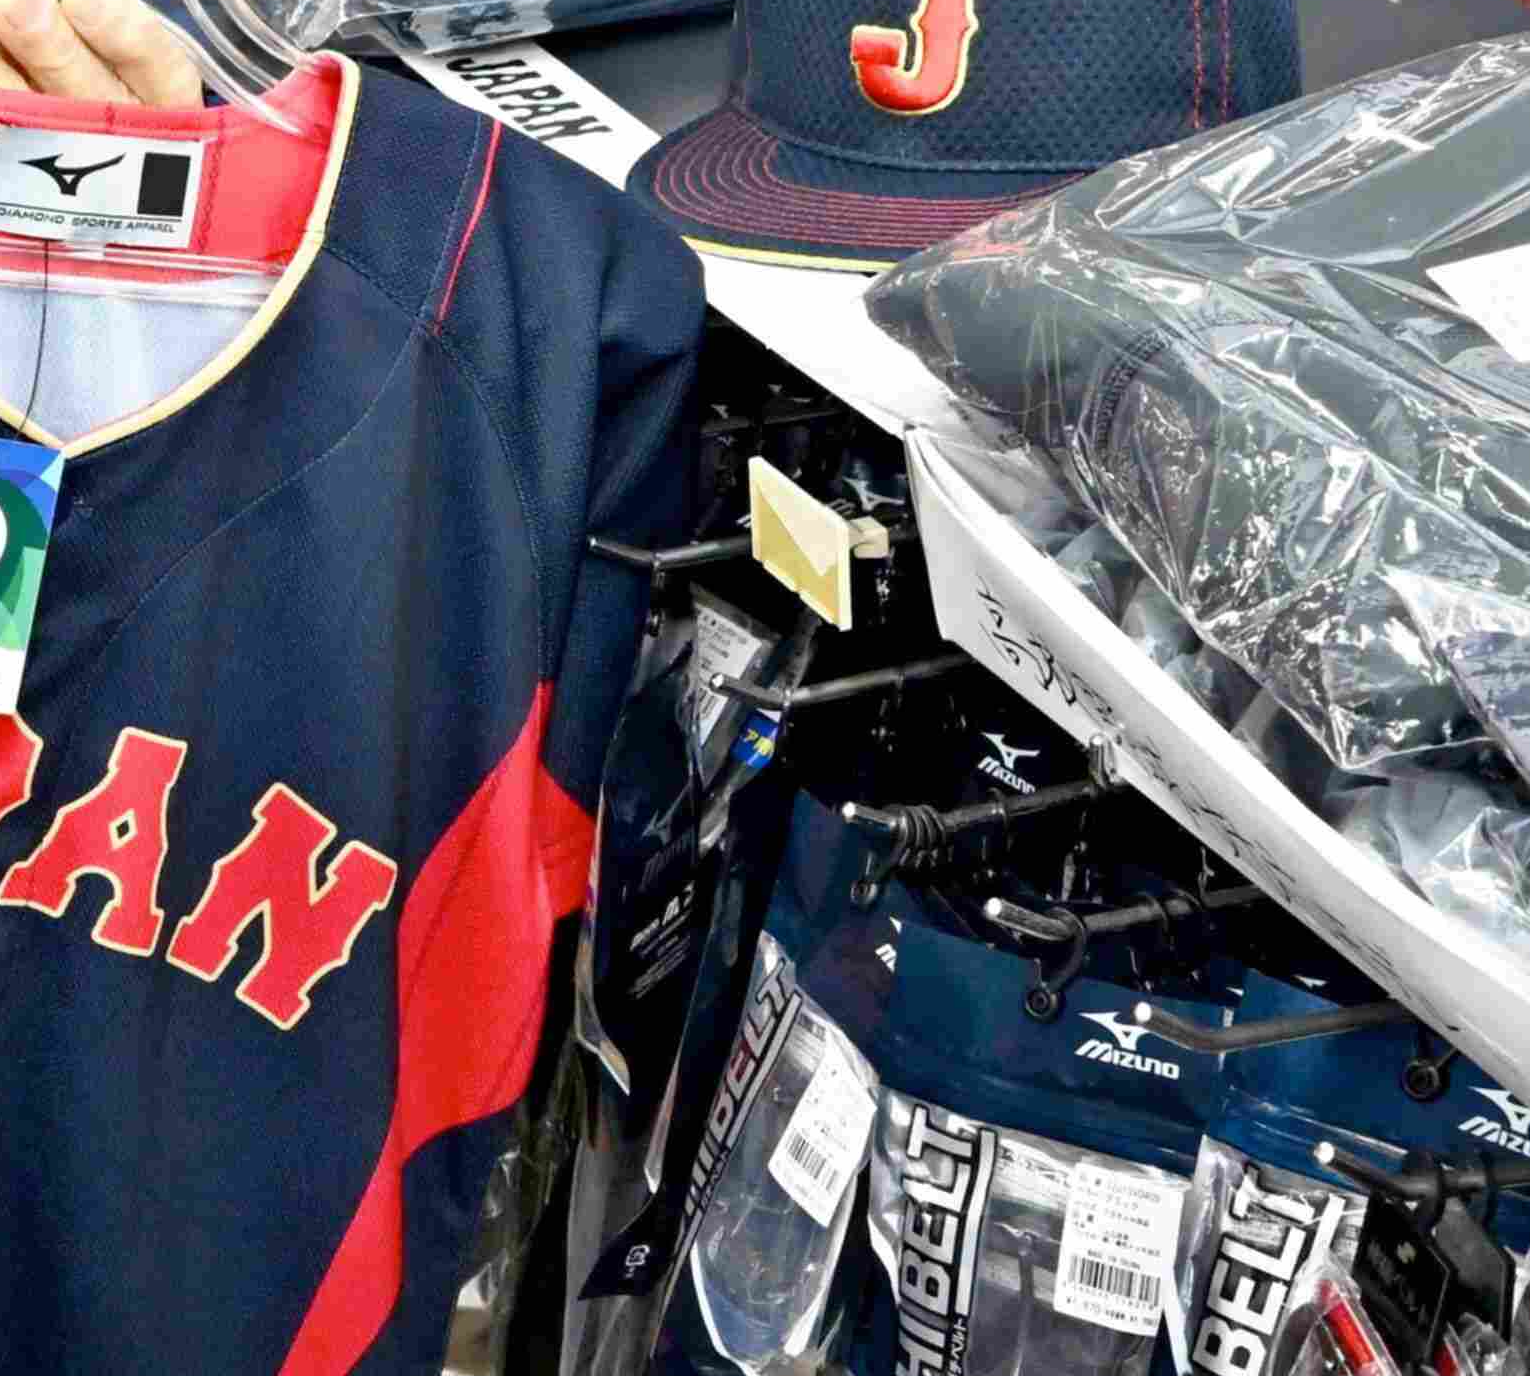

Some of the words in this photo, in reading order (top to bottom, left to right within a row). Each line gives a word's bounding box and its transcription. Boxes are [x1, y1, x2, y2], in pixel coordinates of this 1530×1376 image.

[446, 56, 613, 142] JAPAN
[71, 216, 122, 231] SPORTS
[126, 220, 176, 234] APPAREL
